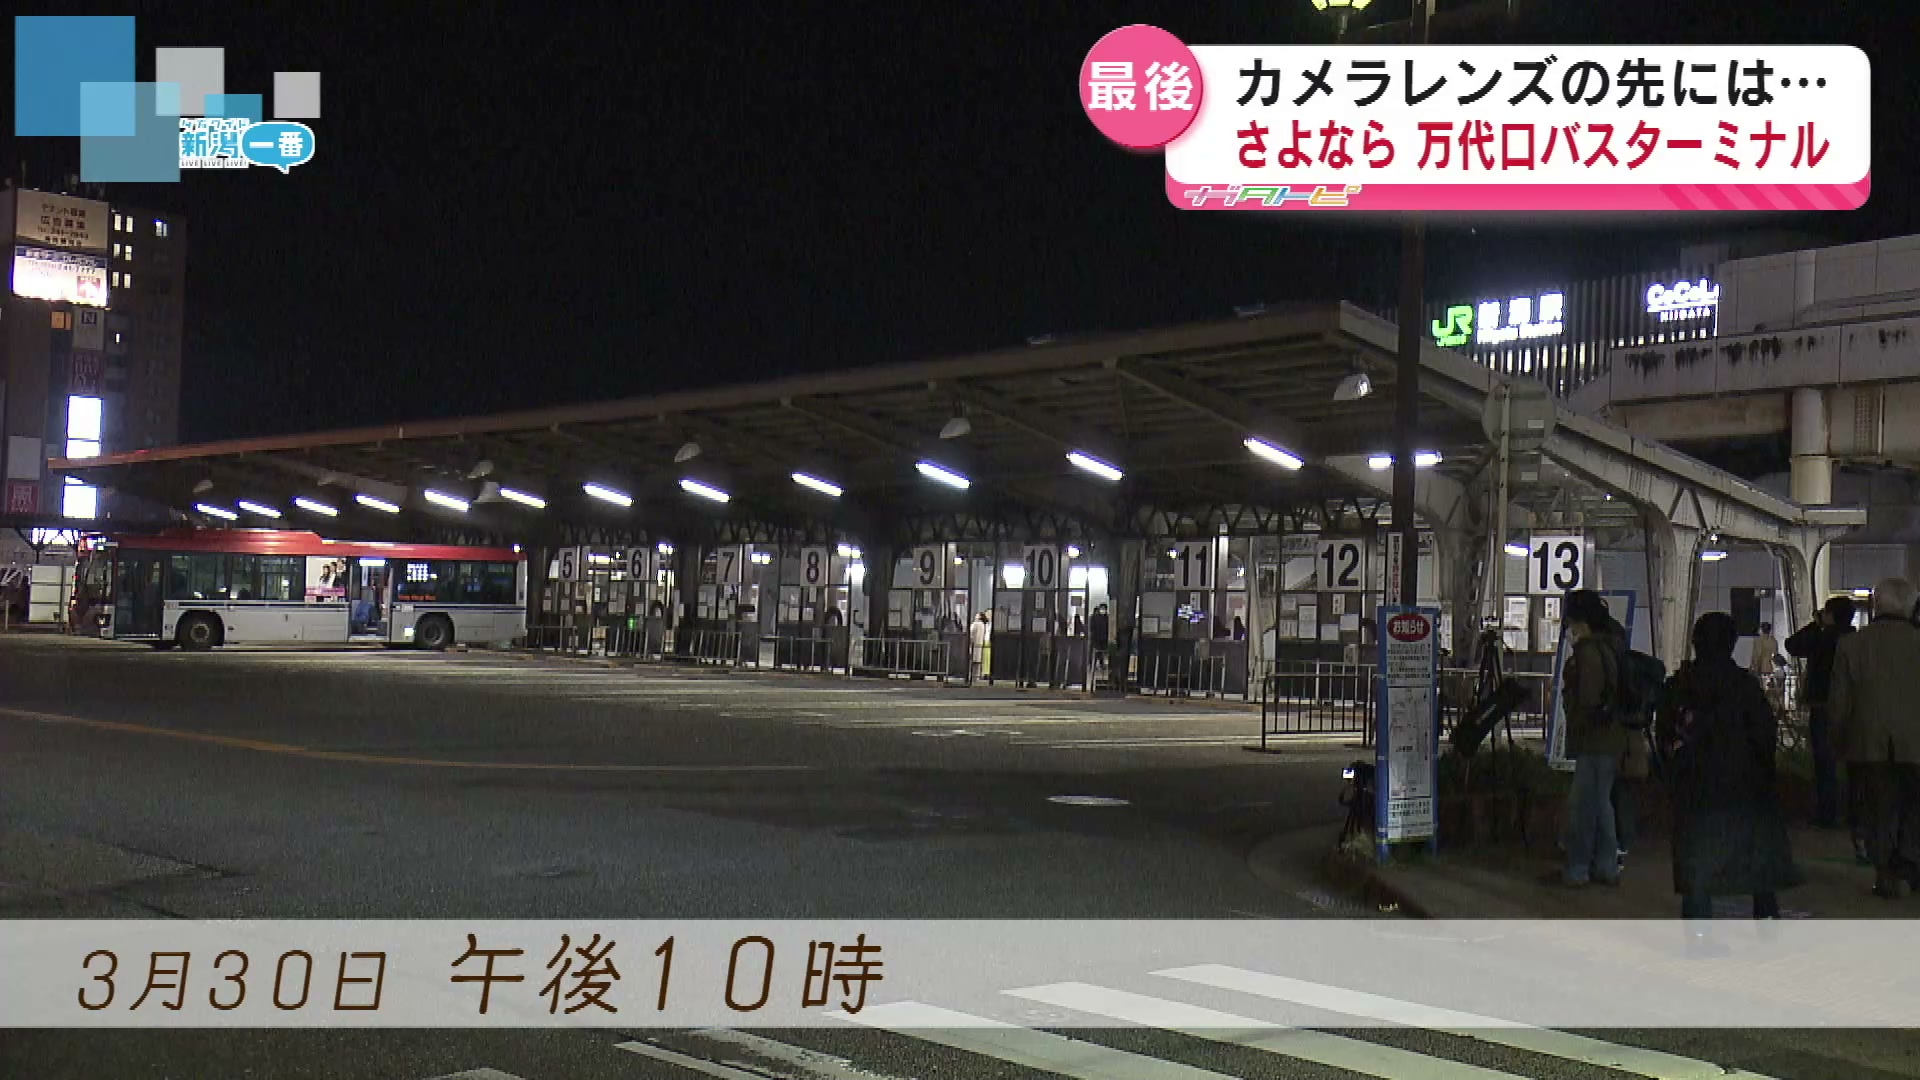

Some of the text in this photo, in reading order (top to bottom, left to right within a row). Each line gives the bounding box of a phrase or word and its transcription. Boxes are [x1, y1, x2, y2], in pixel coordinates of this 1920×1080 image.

[1432, 305, 1474, 337] JR
[561, 551, 574, 578] 5
[631, 550, 643, 578] 6
[721, 550, 736, 583] 7
[805, 550, 821, 584] 8
[919, 550, 936, 584] 9
[1025, 547, 1056, 588] 10
[1180, 545, 1208, 588] 11
[1321, 543, 1360, 588] 12
[1532, 541, 1581, 591] 13
[1393, 619, 1425, 635] お知らせ
